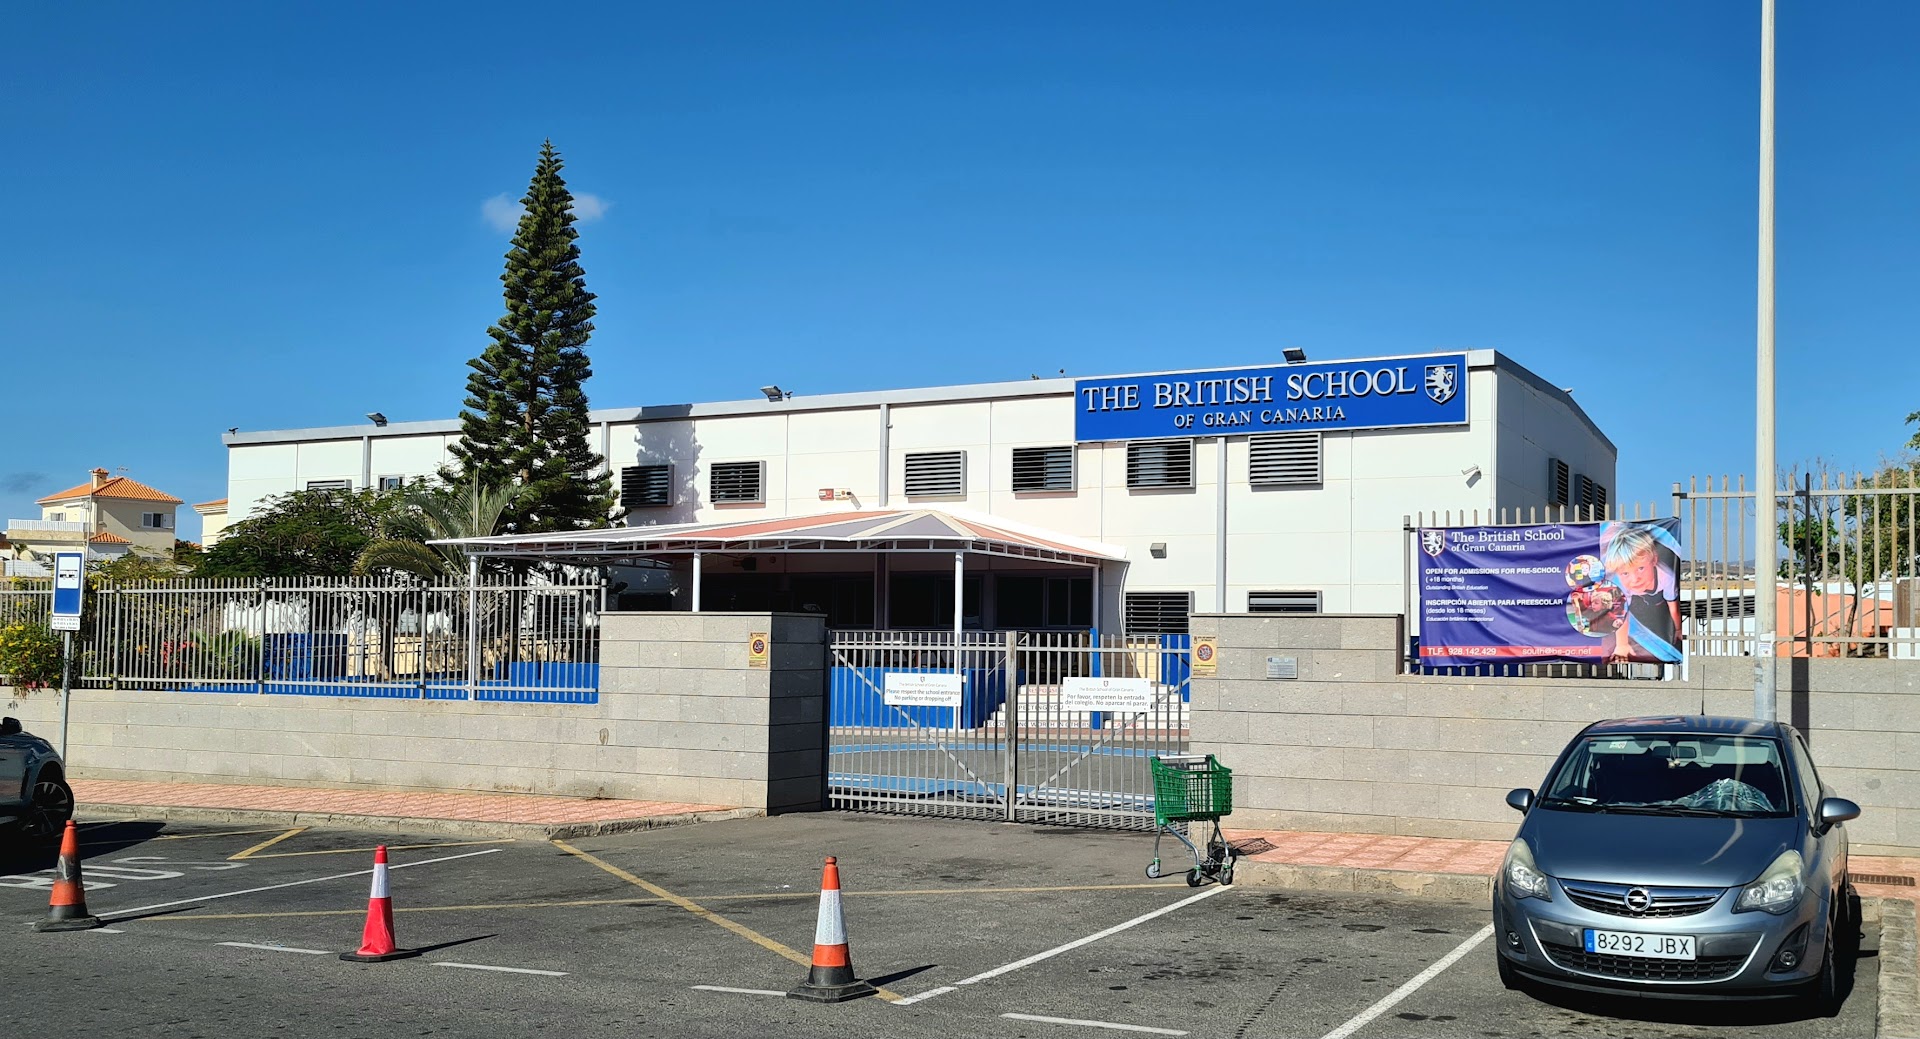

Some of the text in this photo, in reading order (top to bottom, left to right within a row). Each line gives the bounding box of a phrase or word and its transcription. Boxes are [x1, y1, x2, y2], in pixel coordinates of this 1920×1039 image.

[1082, 367, 1418, 413] THE BRITISH SCHOOL
[1174, 405, 1346, 428] OF GRAN CANARIA
[1451, 528, 1565, 543] The British School
[1451, 543, 1526, 552] of Gran Canaria
[1425, 598, 1467, 606] INSCRIPCIÓN
[1516, 598, 1563, 606] PREESCOLAR
[1425, 607, 1446, 615] (desde
[1464, 607, 1486, 615] meses)
[1427, 647, 1444, 655] TLF.
[1448, 647, 1497, 656] 928.142.429
[1597, 933, 1690, 955] 8292 JBX
